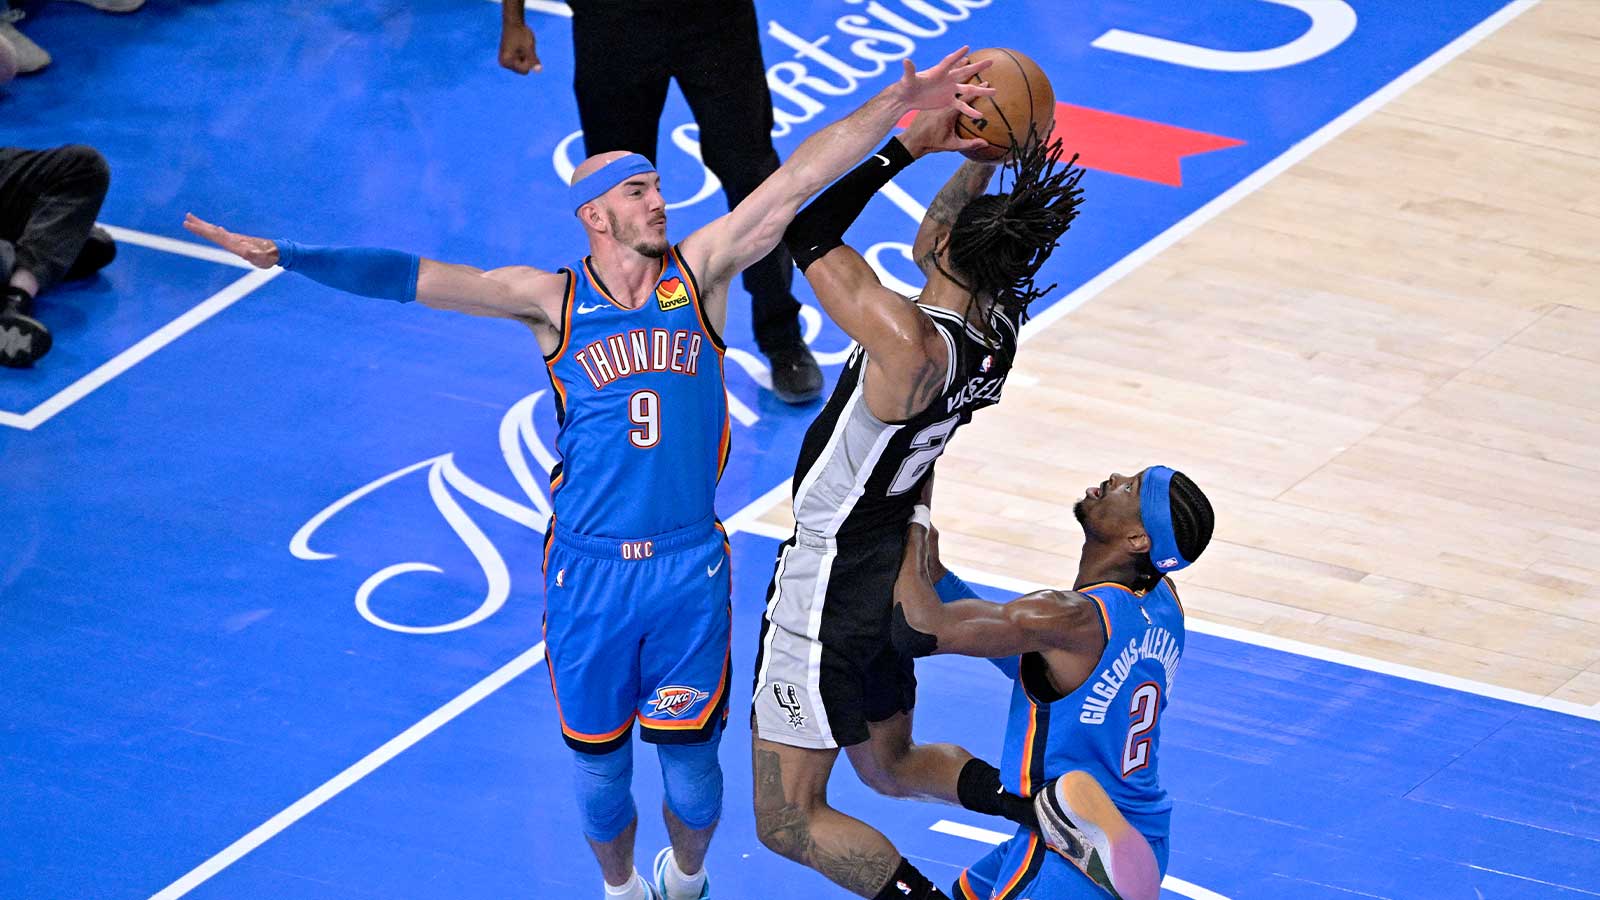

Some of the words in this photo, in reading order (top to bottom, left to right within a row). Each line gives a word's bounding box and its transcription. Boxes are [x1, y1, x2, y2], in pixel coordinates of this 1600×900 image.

[575, 328, 702, 390] THUNDER
[628, 389, 661, 449] 9
[886, 412, 961, 497] 2
[622, 541, 654, 560] OKC
[656, 693, 690, 710] OKC
[1121, 680, 1161, 779] 2
